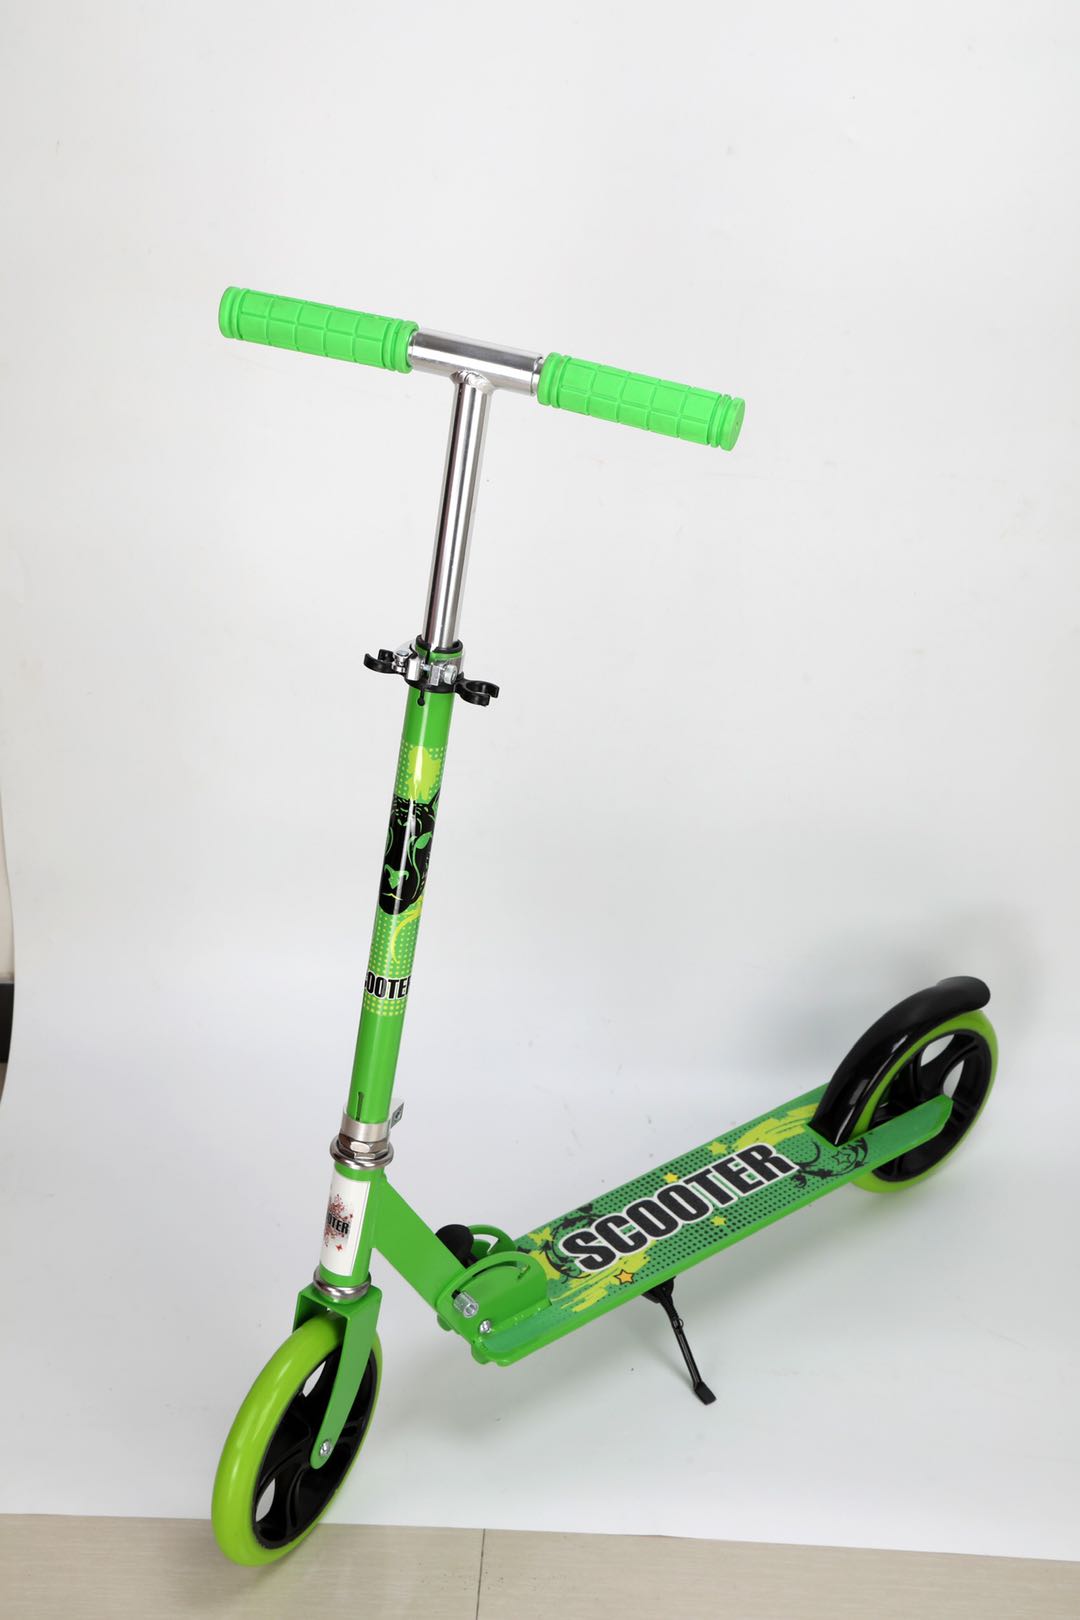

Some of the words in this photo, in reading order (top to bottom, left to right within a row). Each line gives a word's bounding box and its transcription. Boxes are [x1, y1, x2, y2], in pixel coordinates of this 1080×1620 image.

[365, 971, 411, 999] OOTE
[560, 1144, 798, 1272] SCOOTER
[326, 1211, 350, 1235] OTER
